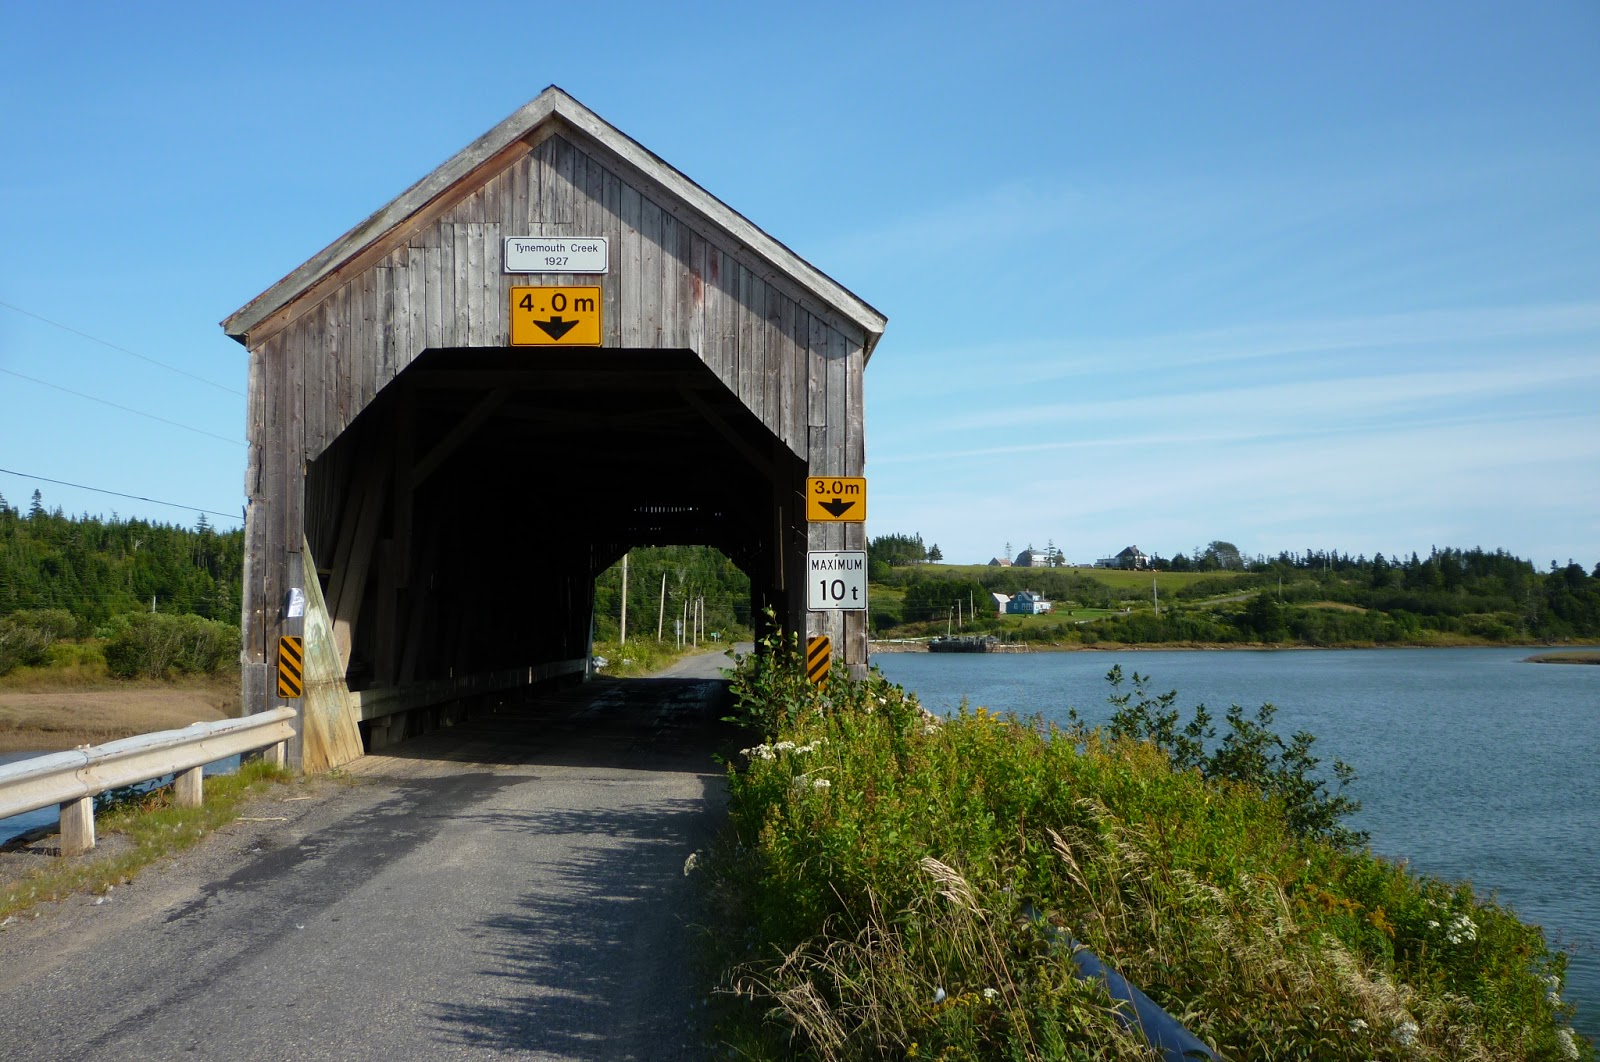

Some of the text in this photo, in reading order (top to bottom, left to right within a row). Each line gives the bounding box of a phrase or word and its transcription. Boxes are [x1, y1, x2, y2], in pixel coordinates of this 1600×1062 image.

[514, 243, 599, 254] Tynemouth Creek
[544, 256, 569, 266] 1927
[811, 559, 862, 570] MAXIMUM
